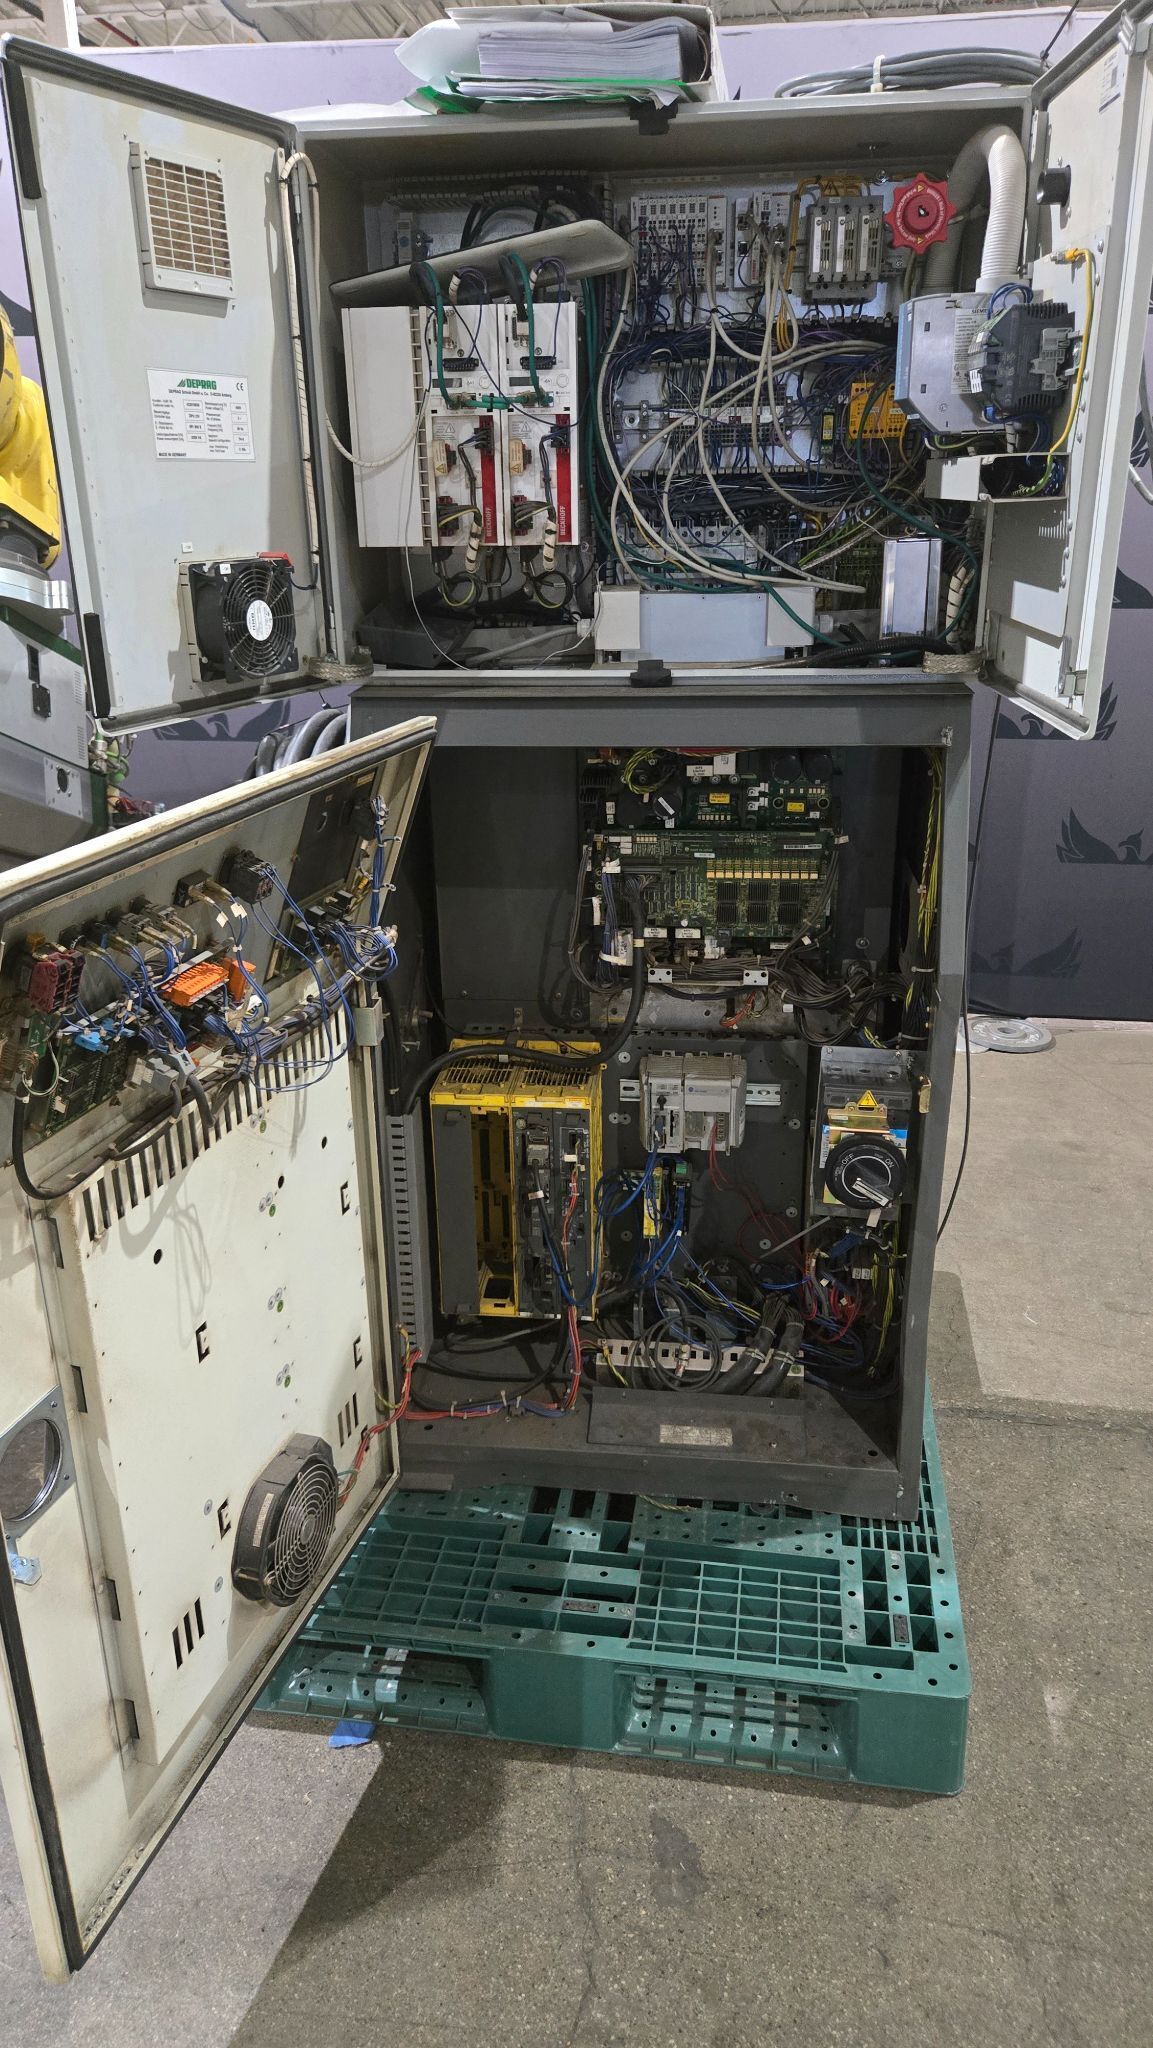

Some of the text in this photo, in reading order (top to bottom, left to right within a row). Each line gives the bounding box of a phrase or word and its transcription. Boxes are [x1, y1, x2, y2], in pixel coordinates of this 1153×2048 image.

[186, 378, 217, 390] DEPRAG
[841, 1153, 895, 1168] OFF ON
